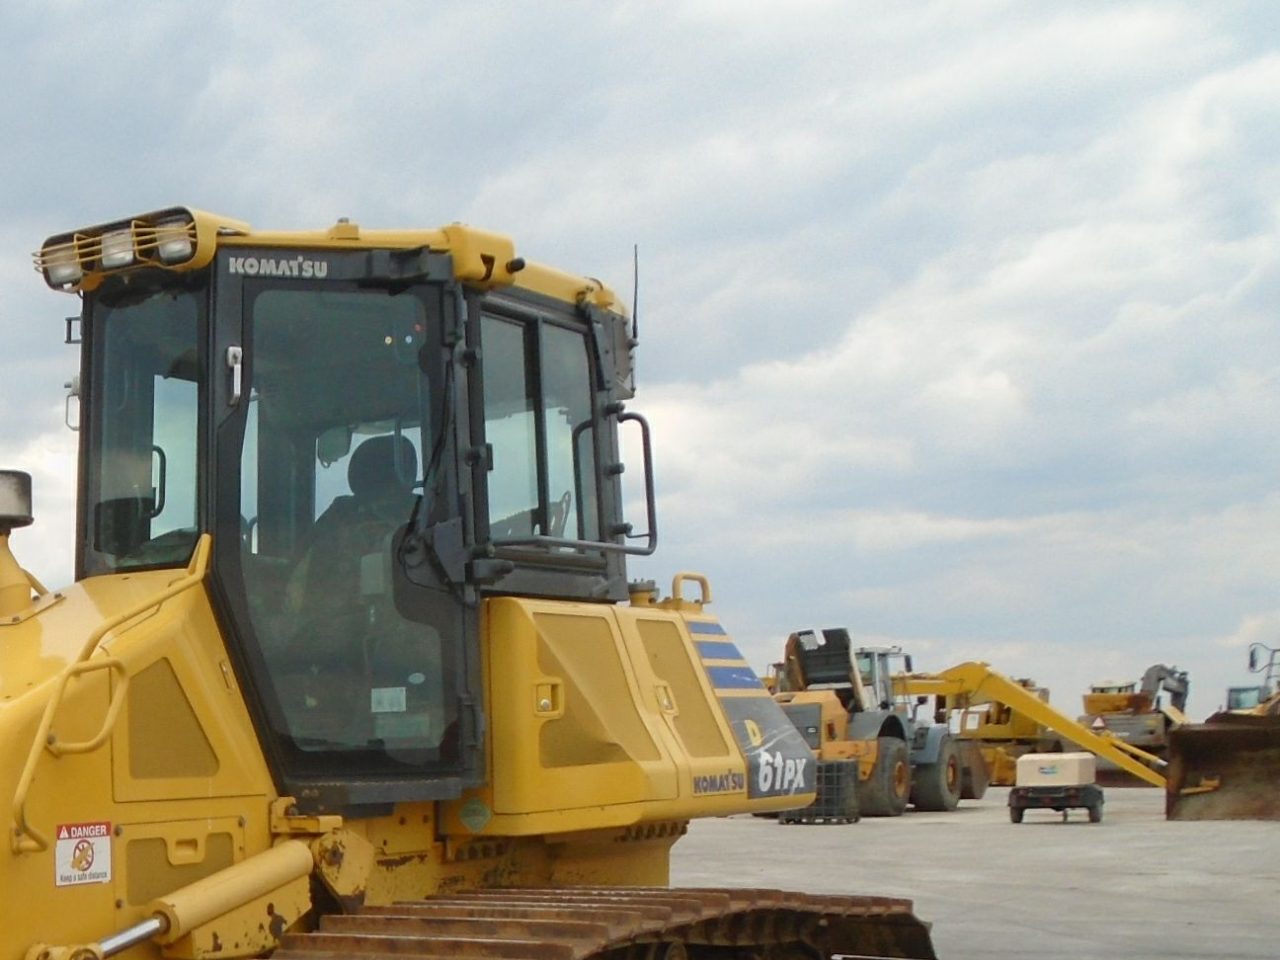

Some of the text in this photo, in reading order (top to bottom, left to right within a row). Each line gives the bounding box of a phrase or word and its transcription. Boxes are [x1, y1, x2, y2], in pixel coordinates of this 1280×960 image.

[228, 256, 328, 278] KOMATSU
[744, 719, 762, 747] D
[693, 768, 745, 793] KOMATSU
[758, 750, 807, 792] 61PX
[70, 825, 107, 838] DANGER
